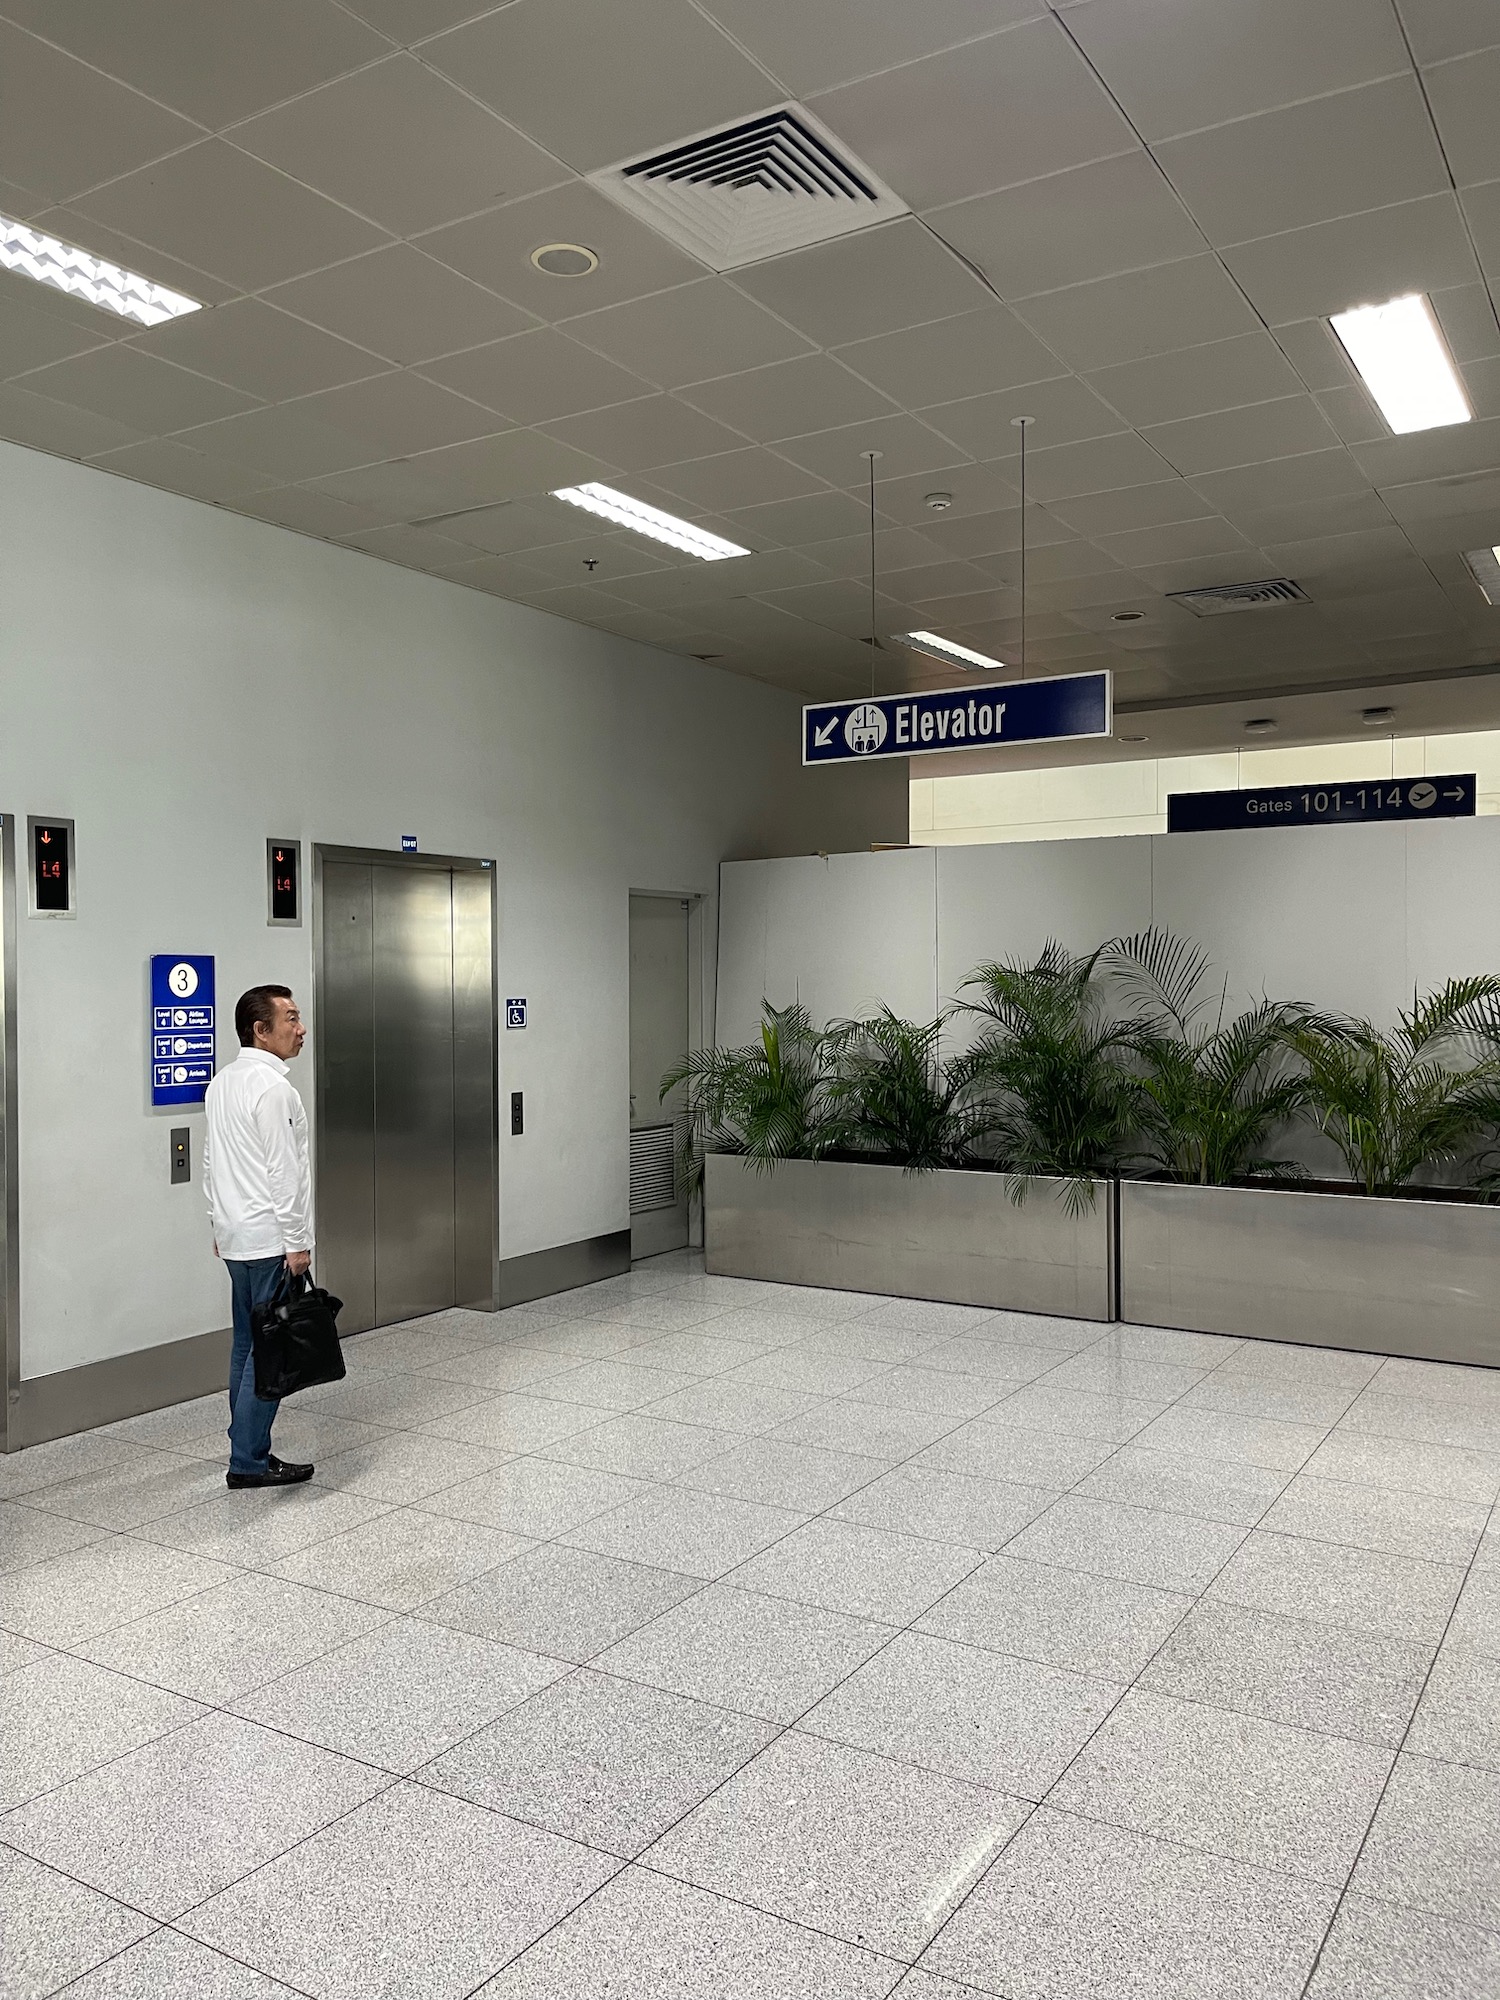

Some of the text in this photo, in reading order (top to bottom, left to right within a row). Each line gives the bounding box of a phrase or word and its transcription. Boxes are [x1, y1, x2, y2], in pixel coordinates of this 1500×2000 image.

[895, 699, 1006, 744] Elevator
[1246, 786, 1403, 814] Gates 101-114
[42, 860, 61, 878] L4
[177, 969, 188, 991] 3
[161, 1046, 167, 1055] 3
[161, 1074, 167, 1083] 2
